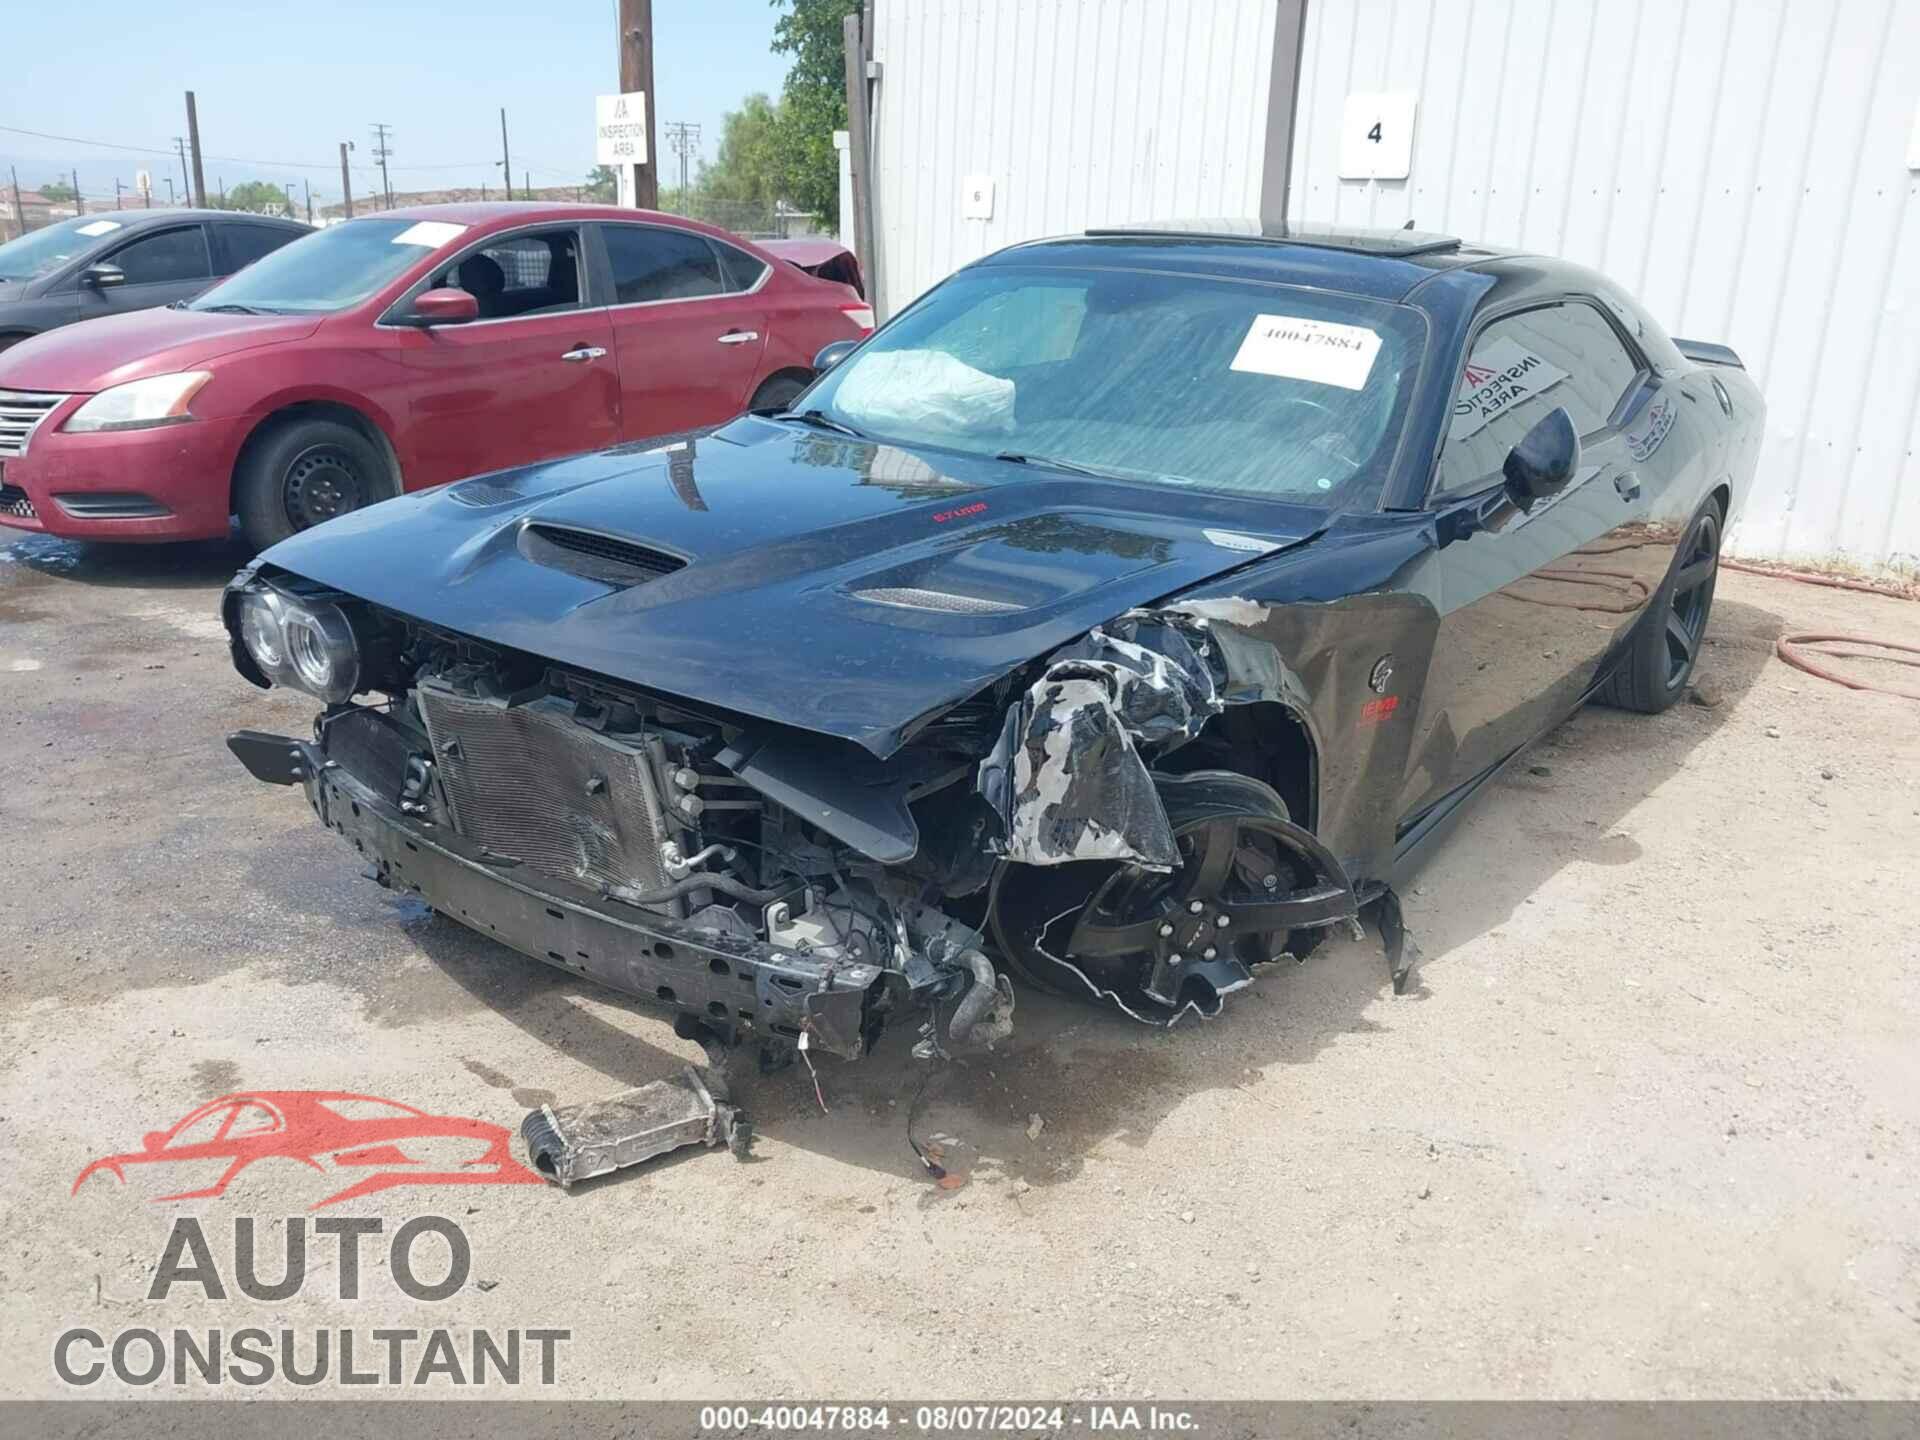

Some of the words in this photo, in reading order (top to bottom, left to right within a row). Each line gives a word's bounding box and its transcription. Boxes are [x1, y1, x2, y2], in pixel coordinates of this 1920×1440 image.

[599, 123, 645, 139] INSPECTION
[1367, 121, 1382, 143] 4
[613, 141, 635, 156] AREA
[973, 190, 982, 202] 6
[1263, 327, 1363, 351] 40047884
